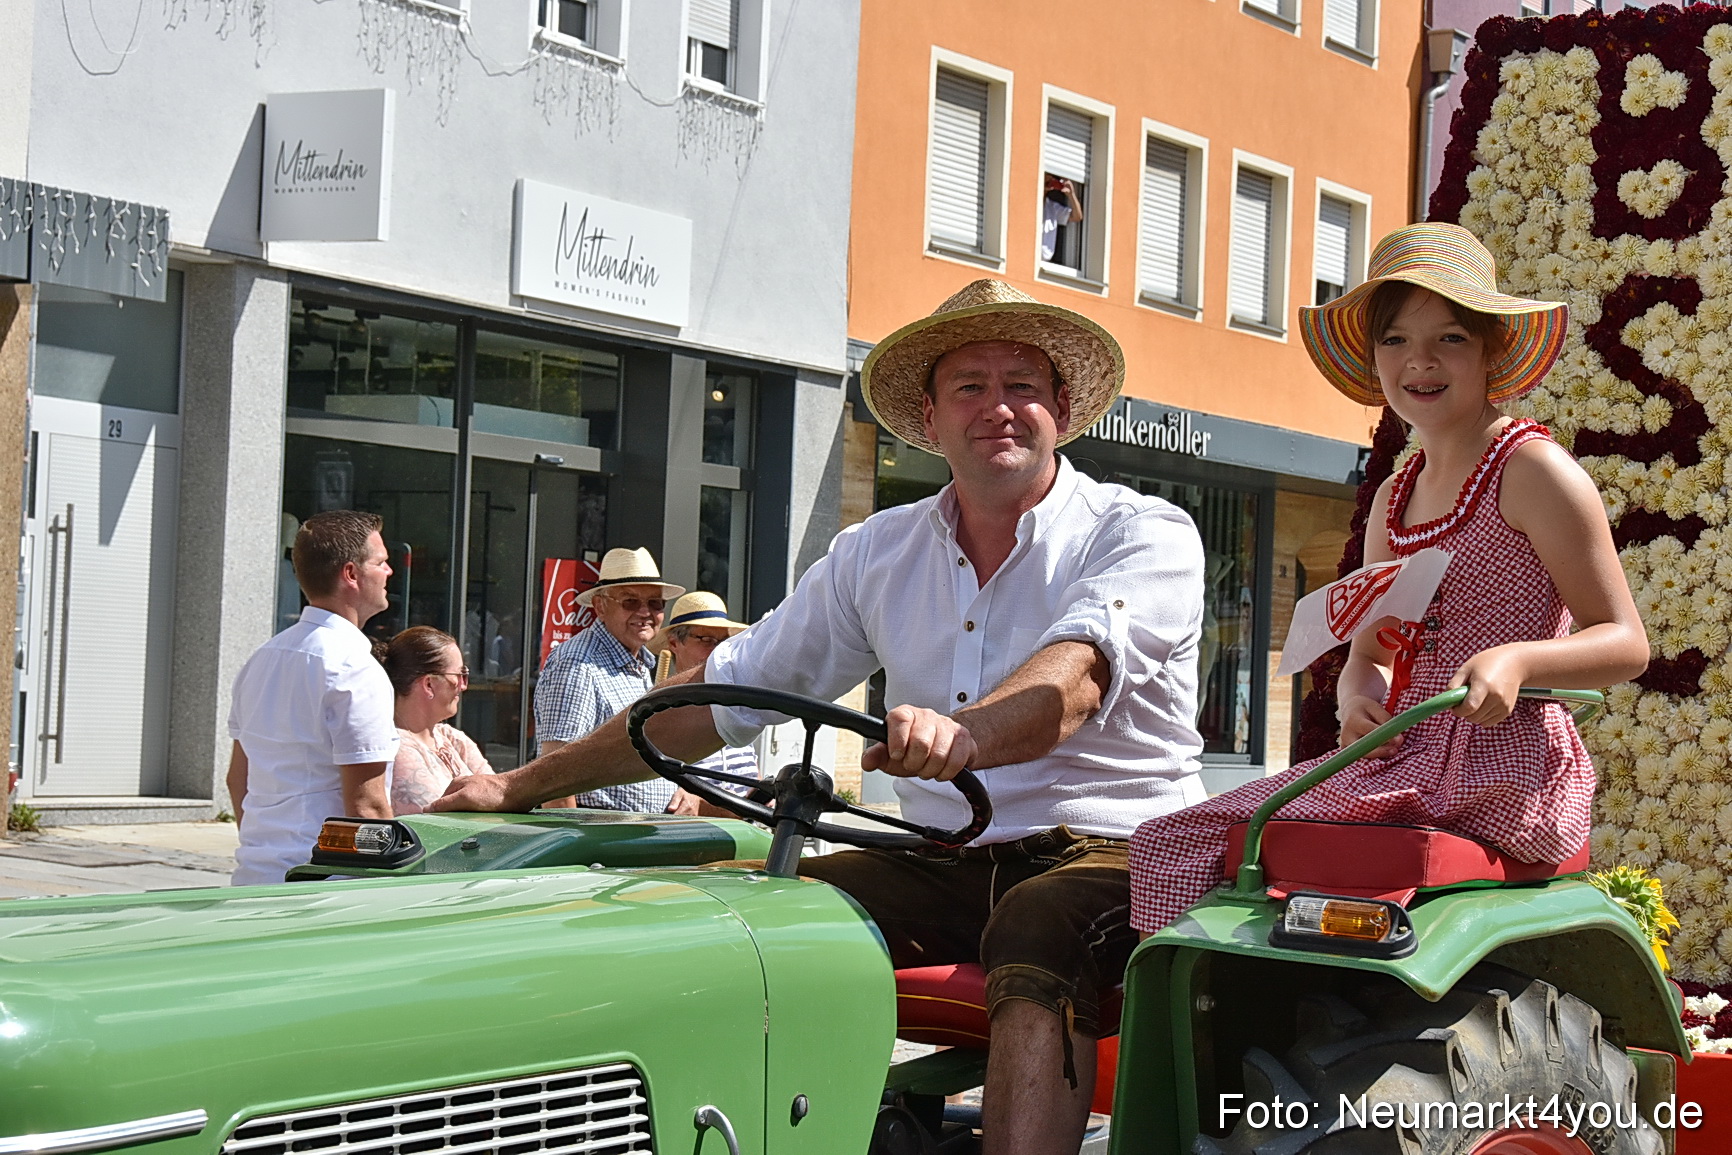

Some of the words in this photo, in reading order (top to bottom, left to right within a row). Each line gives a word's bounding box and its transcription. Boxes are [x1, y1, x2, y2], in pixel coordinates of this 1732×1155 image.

[274, 139, 368, 186] Mittendrin
[554, 201, 660, 288] Mittendrin
[554, 280, 600, 297] WOMEN'S
[605, 291, 647, 306] FASHION
[108, 419, 122, 438] 29
[552, 588, 593, 628] Sale
[1330, 570, 1373, 622] BSC
